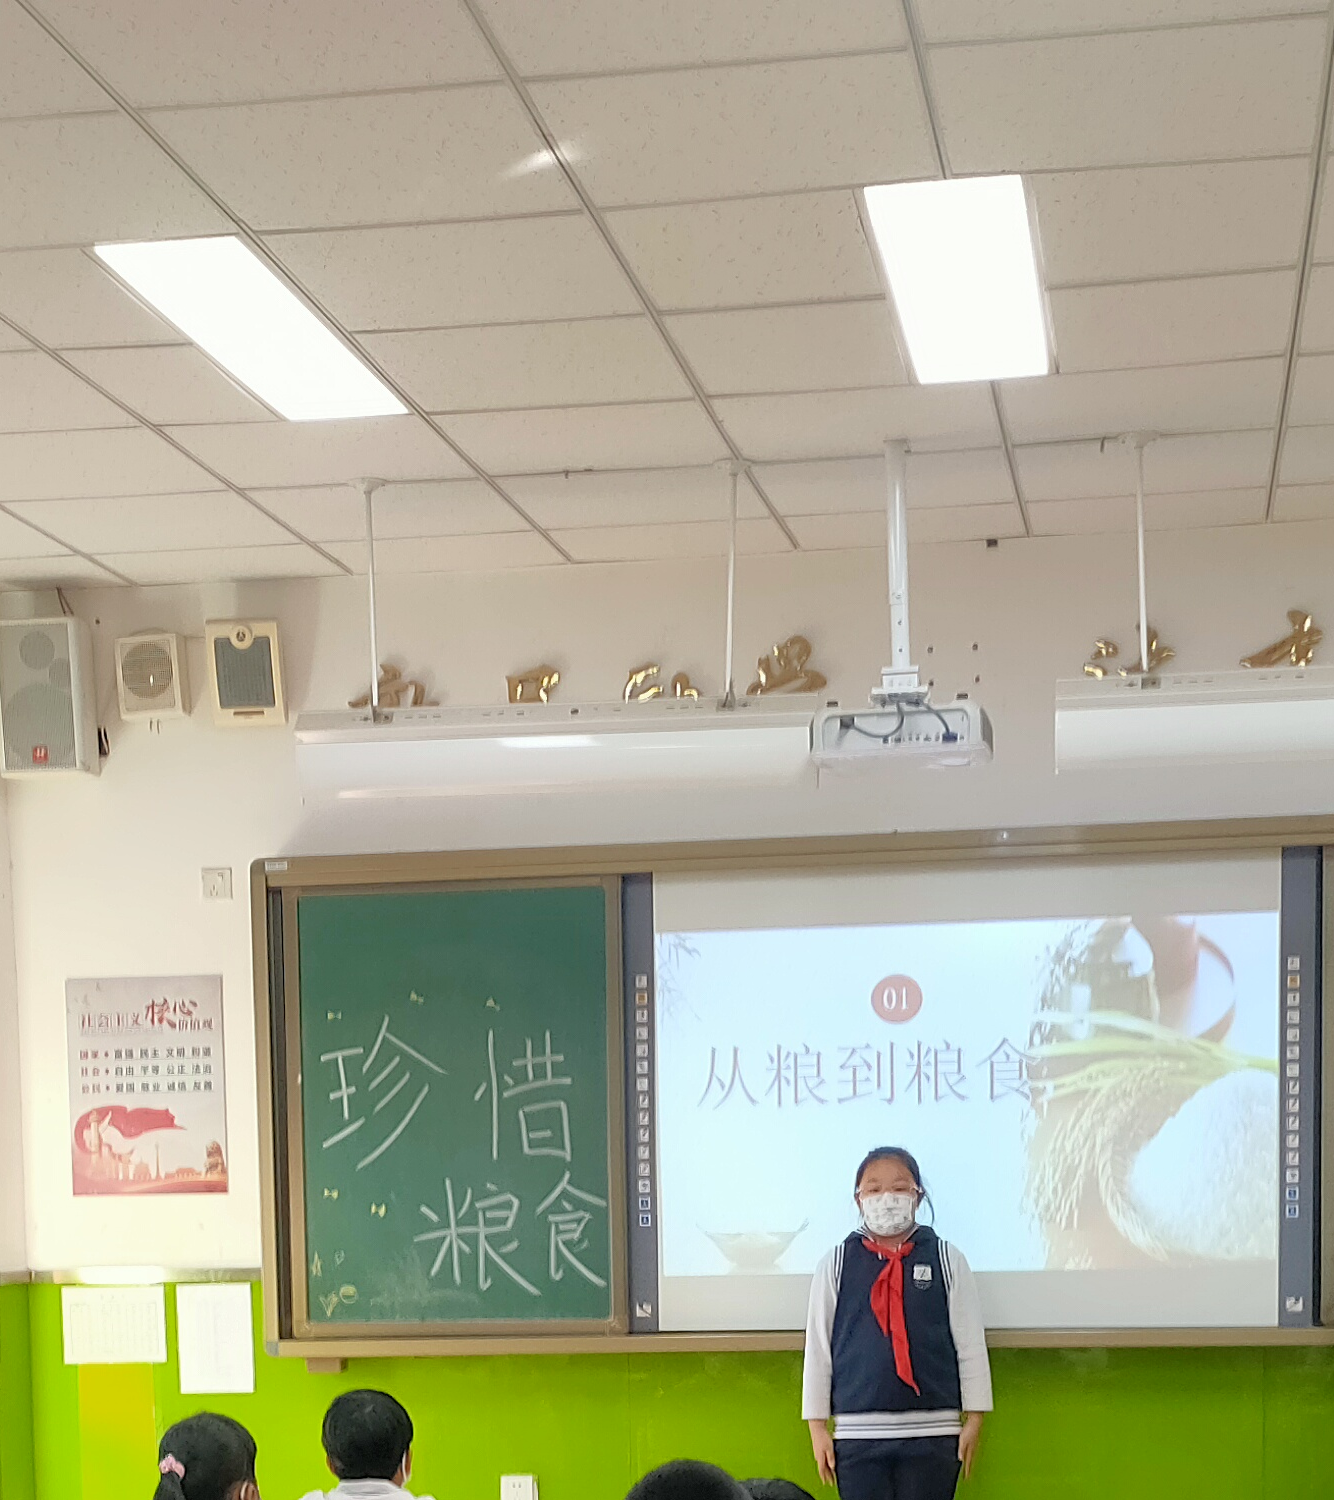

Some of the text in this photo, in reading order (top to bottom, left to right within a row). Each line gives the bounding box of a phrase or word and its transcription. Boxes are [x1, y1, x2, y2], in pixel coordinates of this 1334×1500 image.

[881, 985, 911, 1012] 01
[320, 1014, 573, 1172] 珍惜
[696, 1035, 1037, 1112] 从粮到粮食
[413, 1170, 608, 1296] 粮食
